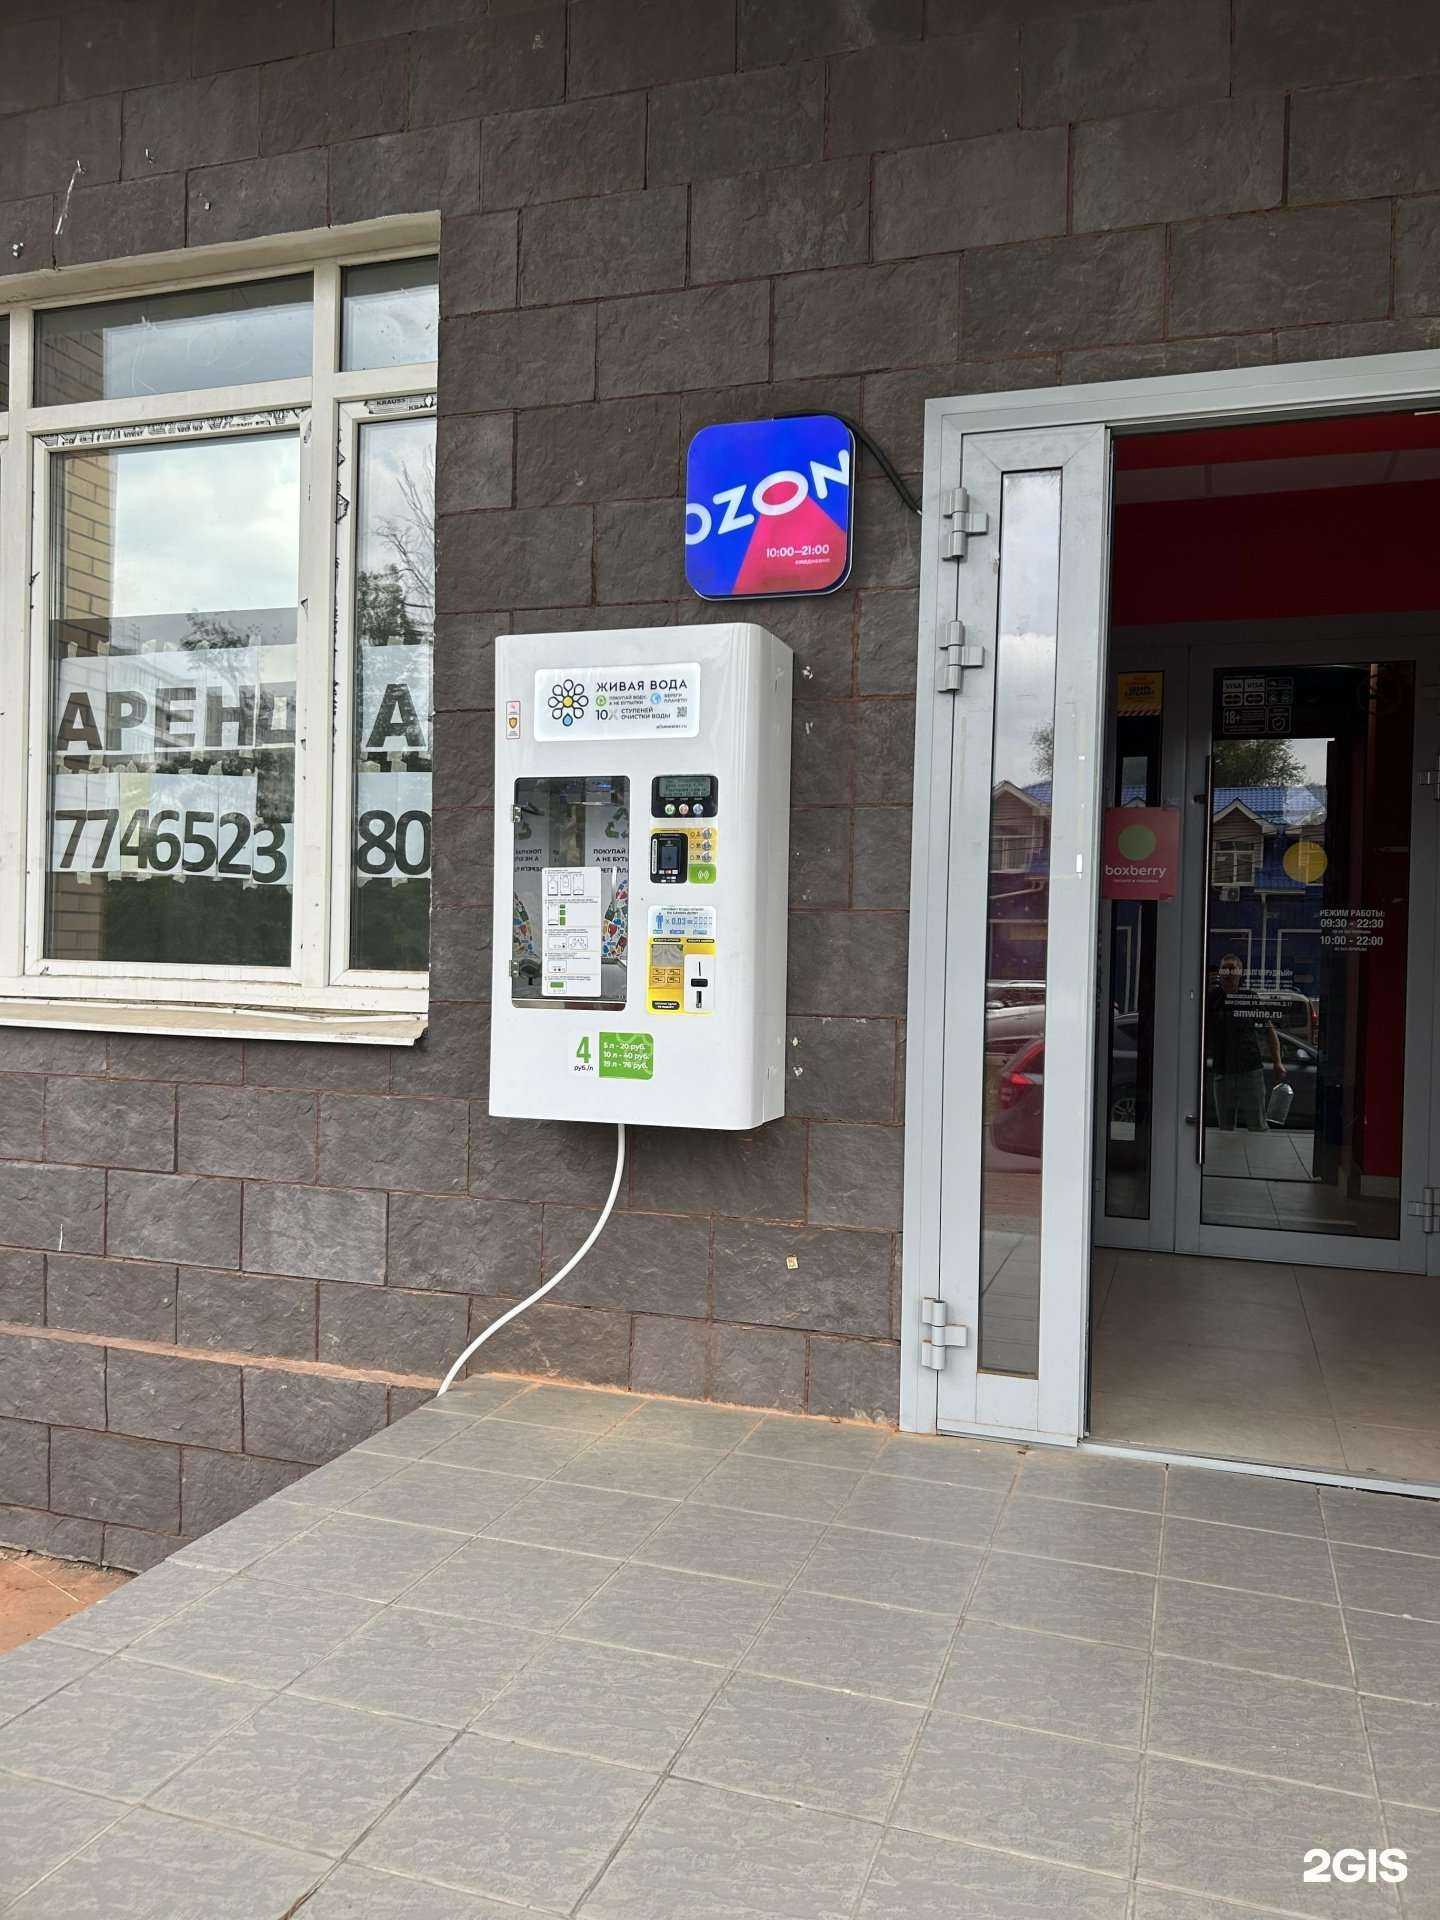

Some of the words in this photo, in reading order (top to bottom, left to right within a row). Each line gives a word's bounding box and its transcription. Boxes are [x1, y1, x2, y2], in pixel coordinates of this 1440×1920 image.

[685, 449, 849, 545] OZON
[596, 681, 645, 692] ЖИВАЯ
[650, 680, 688, 691] ВОДА
[596, 709, 608, 720] 10
[621, 706, 653, 714] СТУПЕНЕЙ
[1105, 864, 1167, 879] boxberry
[1319, 909, 1349, 917] РЕЖИМ
[1320, 918, 1347, 928] 09:30
[1356, 918, 1384, 928] 22:30
[1320, 935, 1347, 945] 10:00
[1356, 936, 1384, 946] 22:00
[1233, 1009, 1282, 1019] amwine.ru
[576, 1036, 591, 1063] 4
